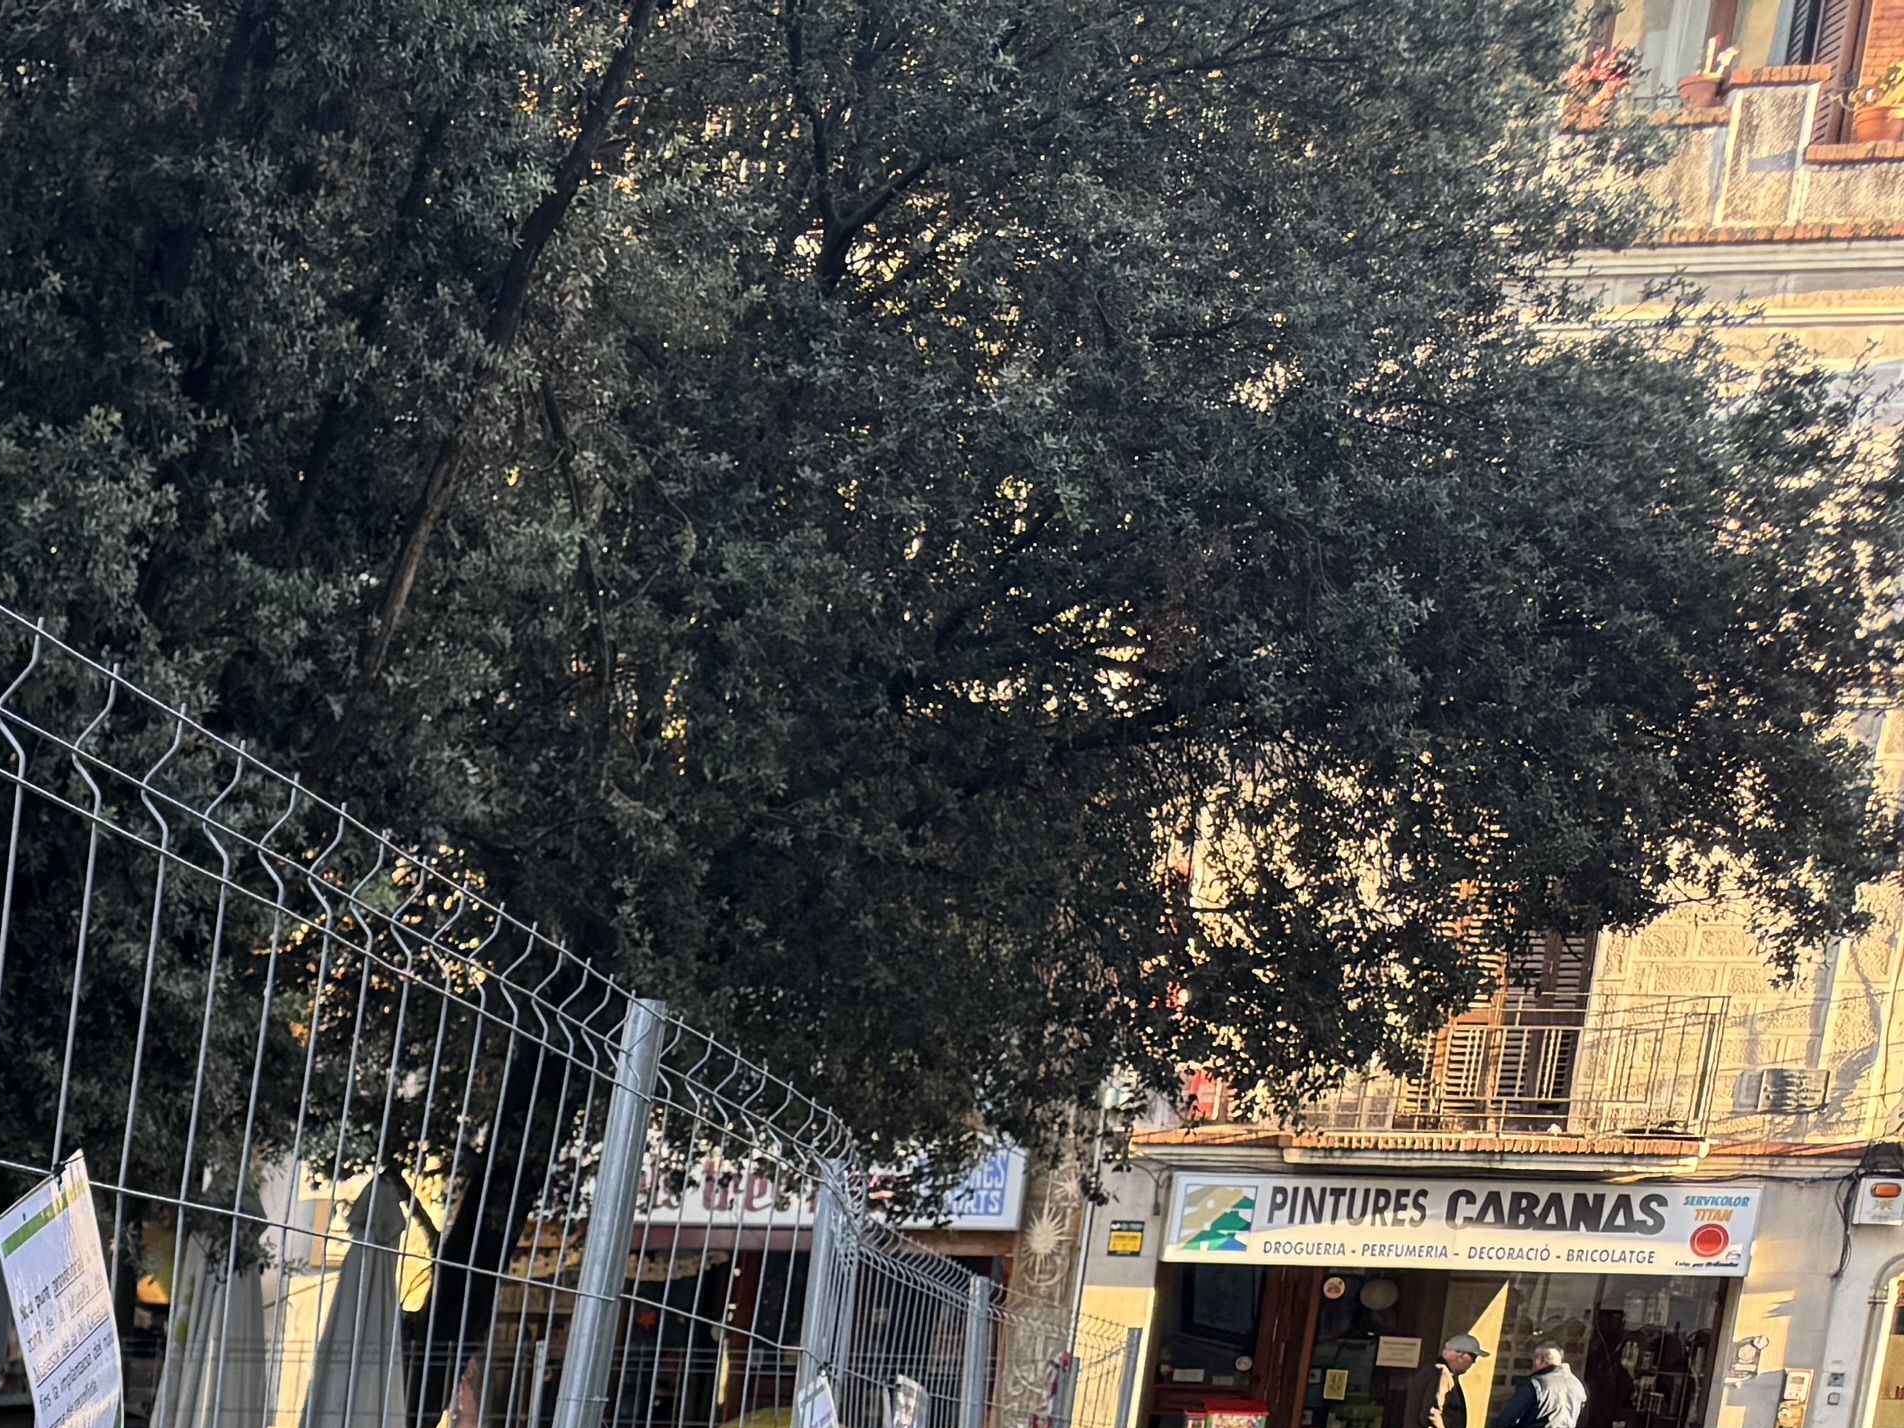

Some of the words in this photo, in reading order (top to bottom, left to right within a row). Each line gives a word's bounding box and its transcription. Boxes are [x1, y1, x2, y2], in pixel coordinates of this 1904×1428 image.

[1267, 1185, 1429, 1229] PINTURES
[1445, 1187, 1669, 1236] CABANAS
[1683, 1195, 1751, 1208] SERVICOLOR
[1694, 1208, 1734, 1223] TITAN
[1262, 1240, 1346, 1257] DROGUERIA
[1361, 1242, 1449, 1260] PERFUMERIA
[1467, 1243, 1551, 1262] DECORACIÓ
[1566, 1247, 1656, 1265] BRICOLATGE
